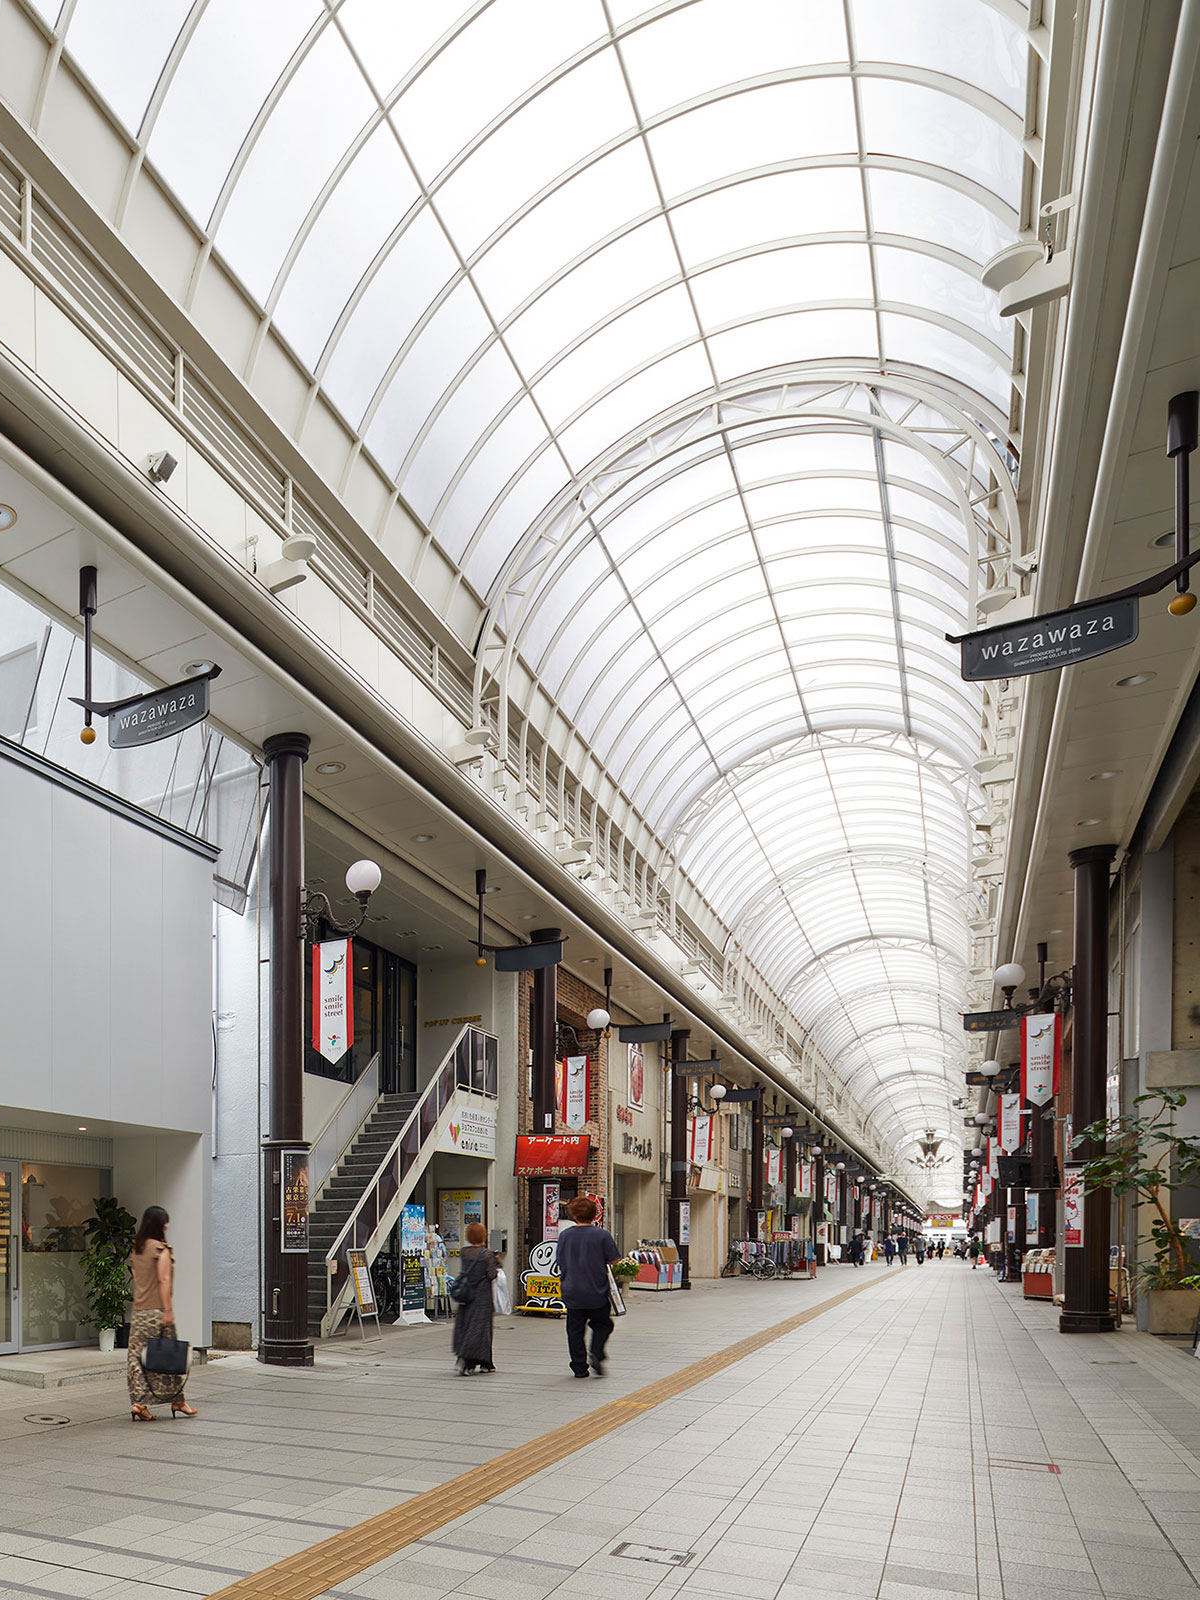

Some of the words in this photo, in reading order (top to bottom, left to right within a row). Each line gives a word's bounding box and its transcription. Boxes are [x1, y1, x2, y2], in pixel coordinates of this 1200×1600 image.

[981, 615, 1115, 660] wazawaza
[119, 693, 196, 730] wazawaza
[324, 994, 344, 1003] smile
[324, 1001, 344, 1010] smile
[324, 1008, 344, 1017] street
[528, 1136, 580, 1145] アーケード内
[518, 1166, 585, 1175] スケボー禁止です
[530, 1285, 559, 1295] OITA
